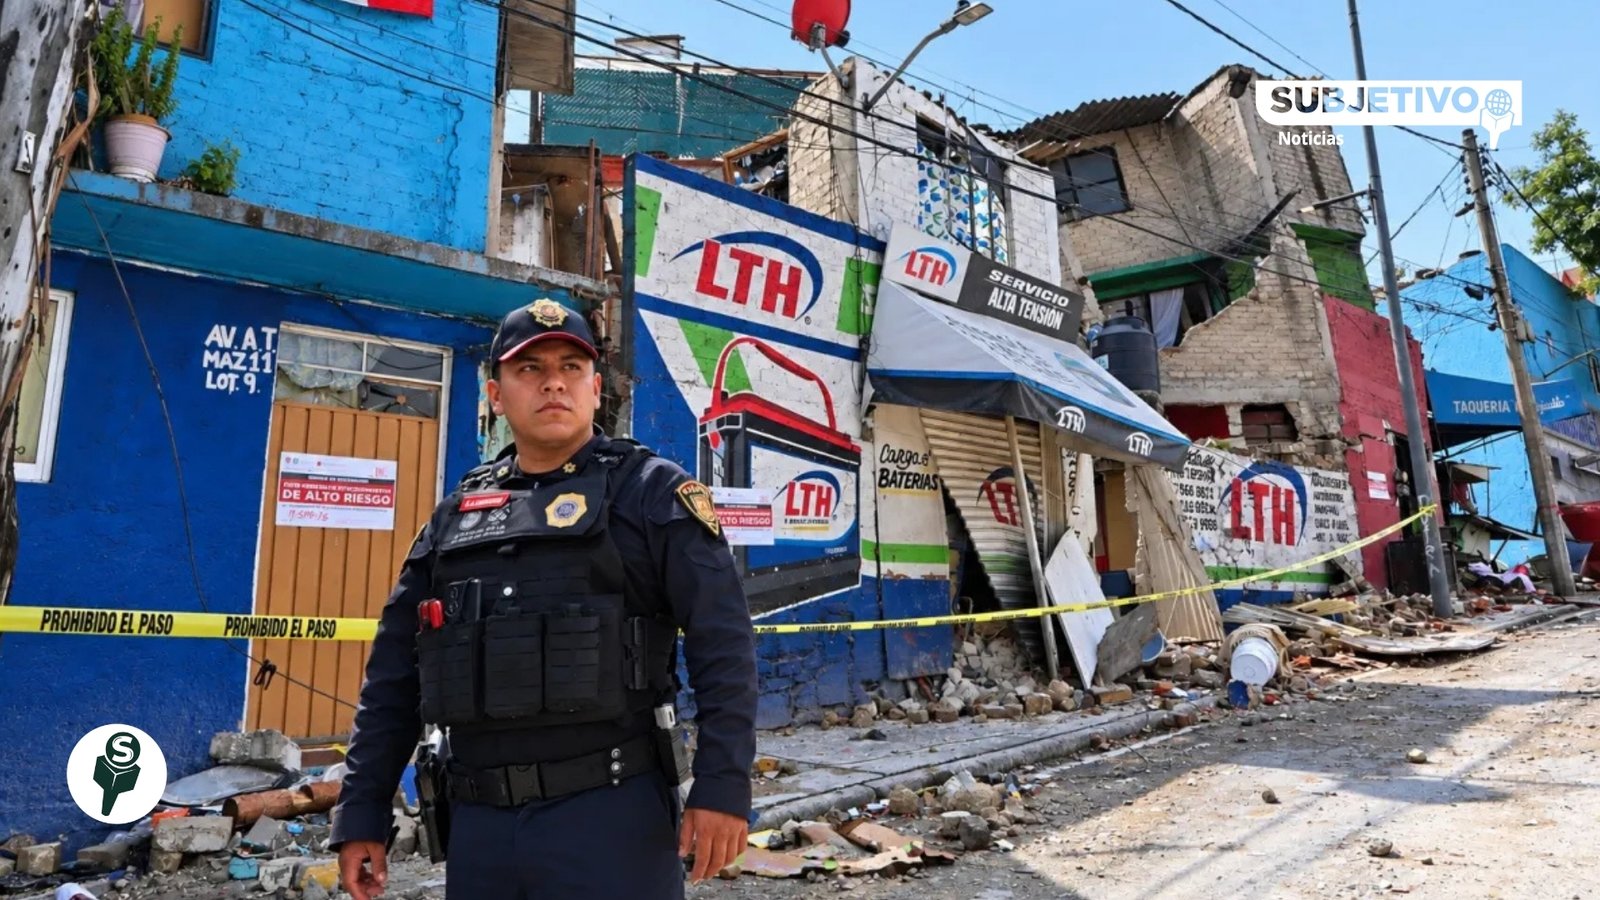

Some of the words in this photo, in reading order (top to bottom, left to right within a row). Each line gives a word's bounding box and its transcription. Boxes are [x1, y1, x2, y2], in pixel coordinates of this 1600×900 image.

[696, 239, 802, 319] LTH
[904, 250, 949, 286] LTH
[987, 287, 1018, 315] ALTA
[989, 269, 1069, 307] SERVICIO
[1452, 400, 1511, 414] TAQUERIA
[1056, 411, 1085, 435] LTH
[1128, 437, 1151, 457] LTH
[878, 467, 939, 491] BATERIAS
[282, 489, 301, 500] DE
[305, 491, 340, 502] ALTO
[343, 492, 391, 505] RIESGO
[784, 481, 832, 518] LTH
[1231, 477, 1296, 547] LTH
[40, 609, 118, 633] PROHIBIDO
[118, 612, 135, 634] EL
[138, 613, 174, 636] PASO
[223, 615, 288, 638] PROHIBIDO
[289, 617, 303, 638] EL
[305, 619, 337, 639] PASO
